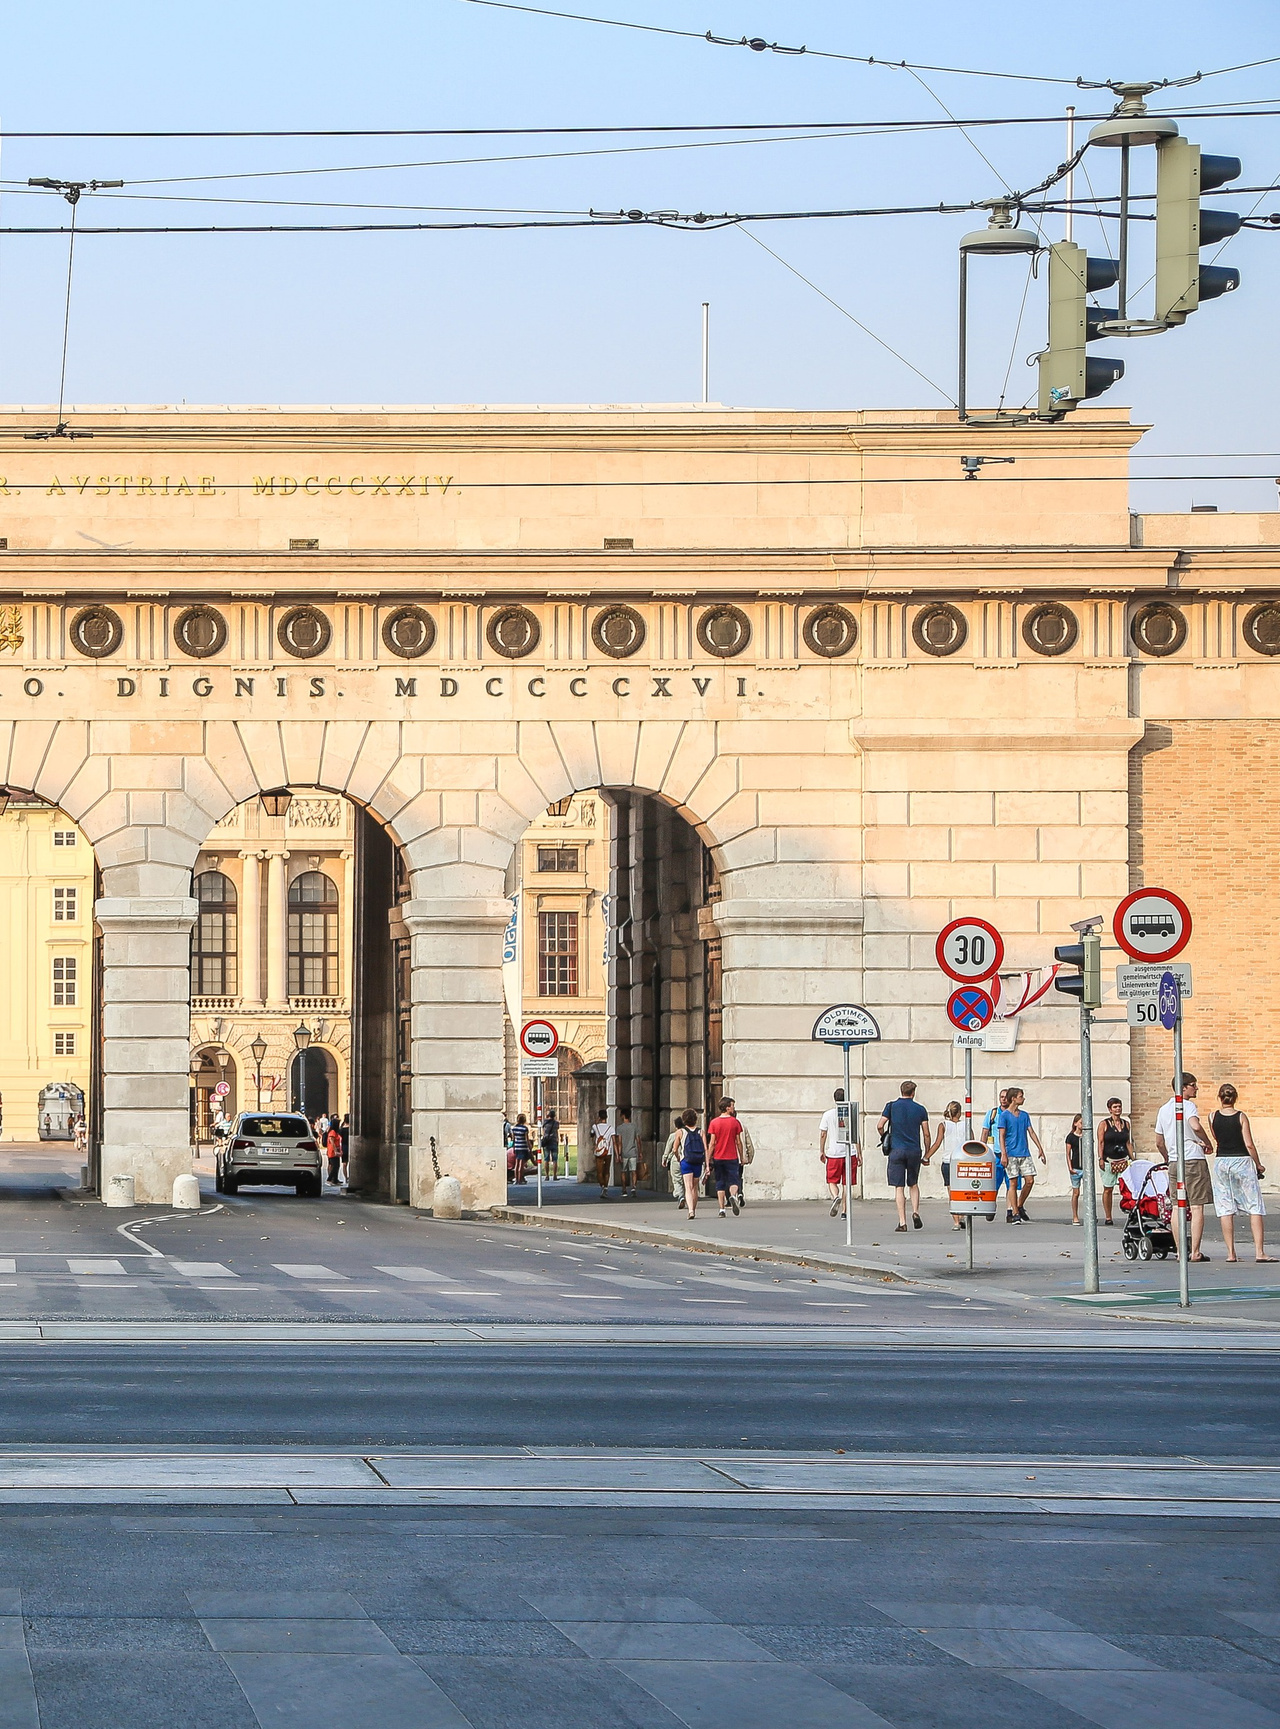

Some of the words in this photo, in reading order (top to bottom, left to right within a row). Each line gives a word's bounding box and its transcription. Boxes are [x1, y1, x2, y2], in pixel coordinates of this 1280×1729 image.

[45, 475, 226, 496] AVSTRIAE.
[252, 475, 462, 496] MDCCCXXIV.
[117, 677, 344, 698] DIGNIS.
[395, 677, 765, 698] MDCCCCXVI.
[955, 935, 985, 965] 30
[824, 1009, 868, 1024] OLDTIMER
[1136, 1003, 1157, 1022] 50
[819, 1028, 874, 1036] BUSTOURS
[957, 1035, 983, 1046] Anfang
